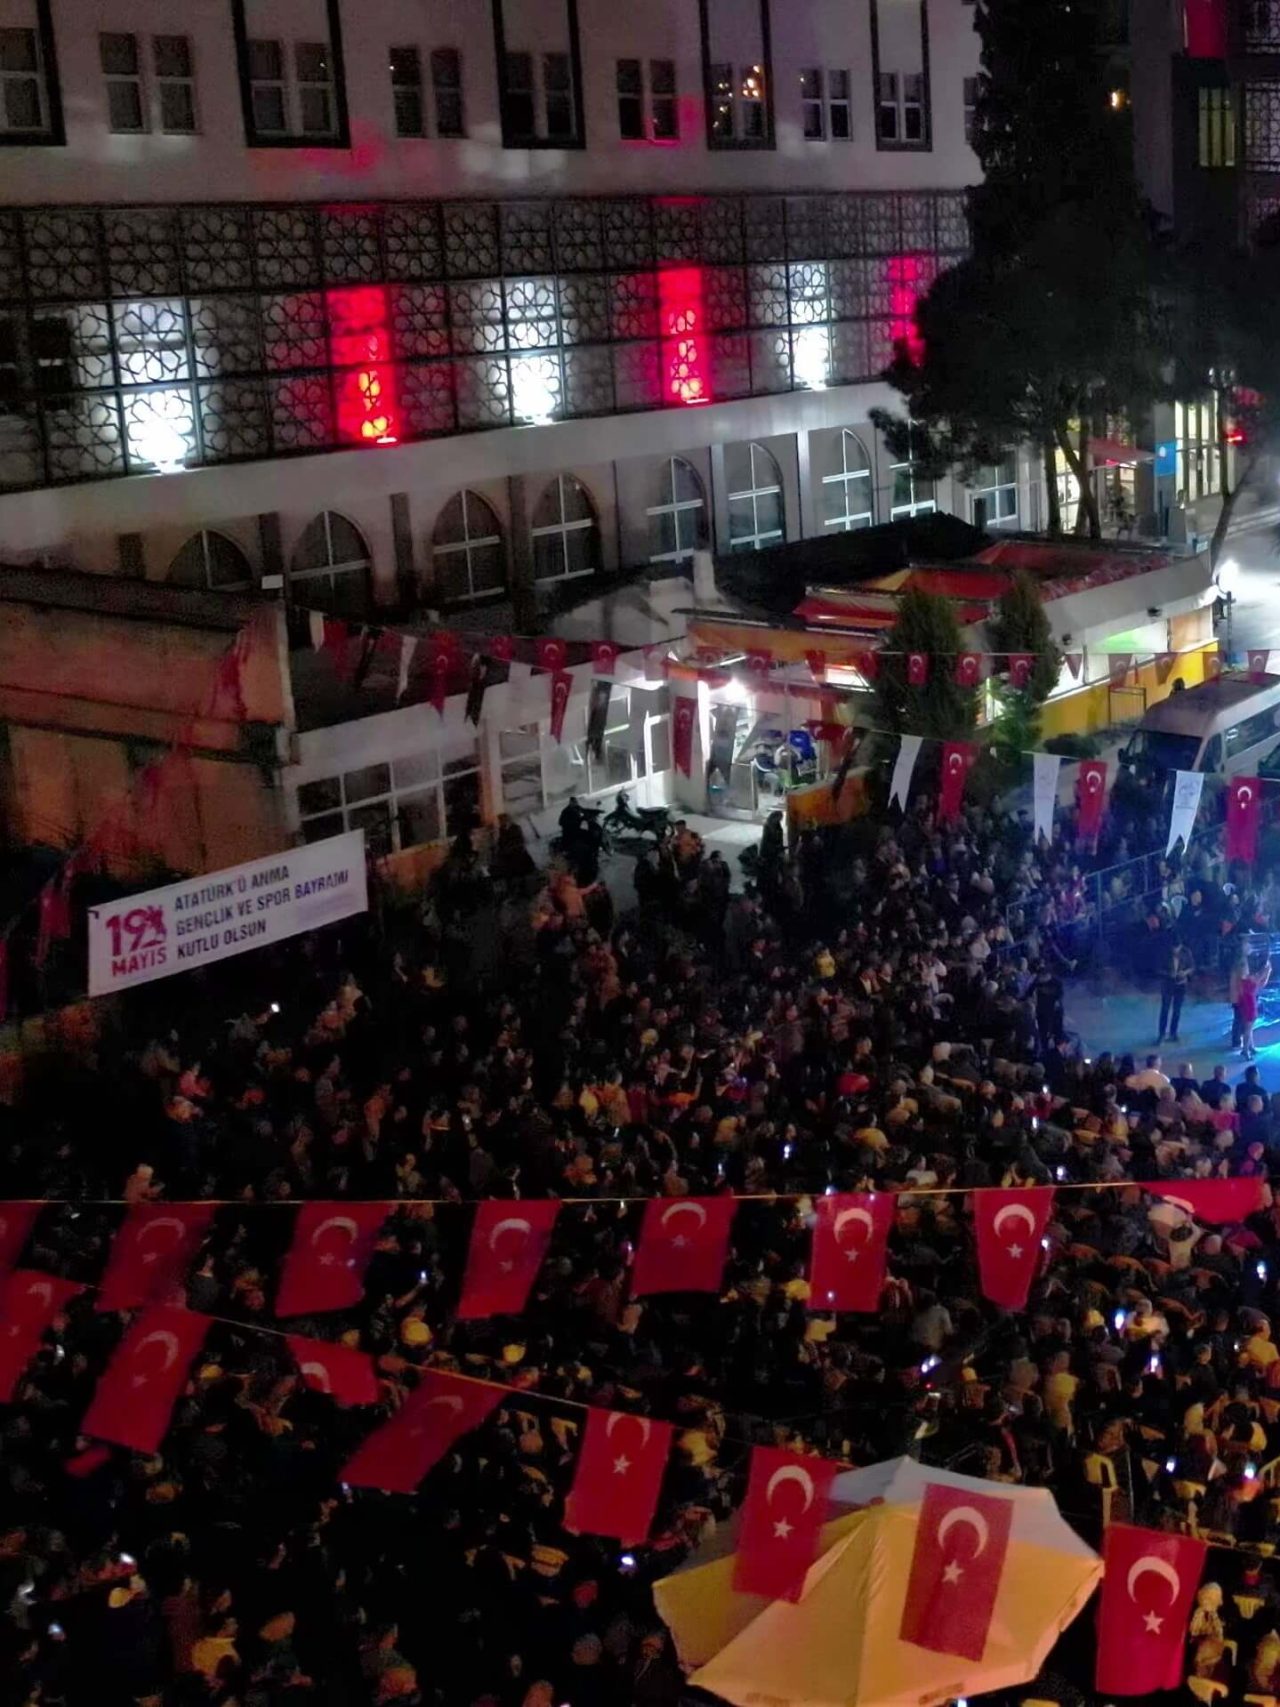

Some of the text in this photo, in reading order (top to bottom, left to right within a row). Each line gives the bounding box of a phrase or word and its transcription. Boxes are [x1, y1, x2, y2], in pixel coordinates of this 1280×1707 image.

[251, 866, 290, 890] ANMA
[237, 900, 252, 917] VE
[258, 888, 291, 911] SPOR
[177, 920, 267, 960] KUTLU OLSUN
[111, 947, 167, 977] MAYIS
